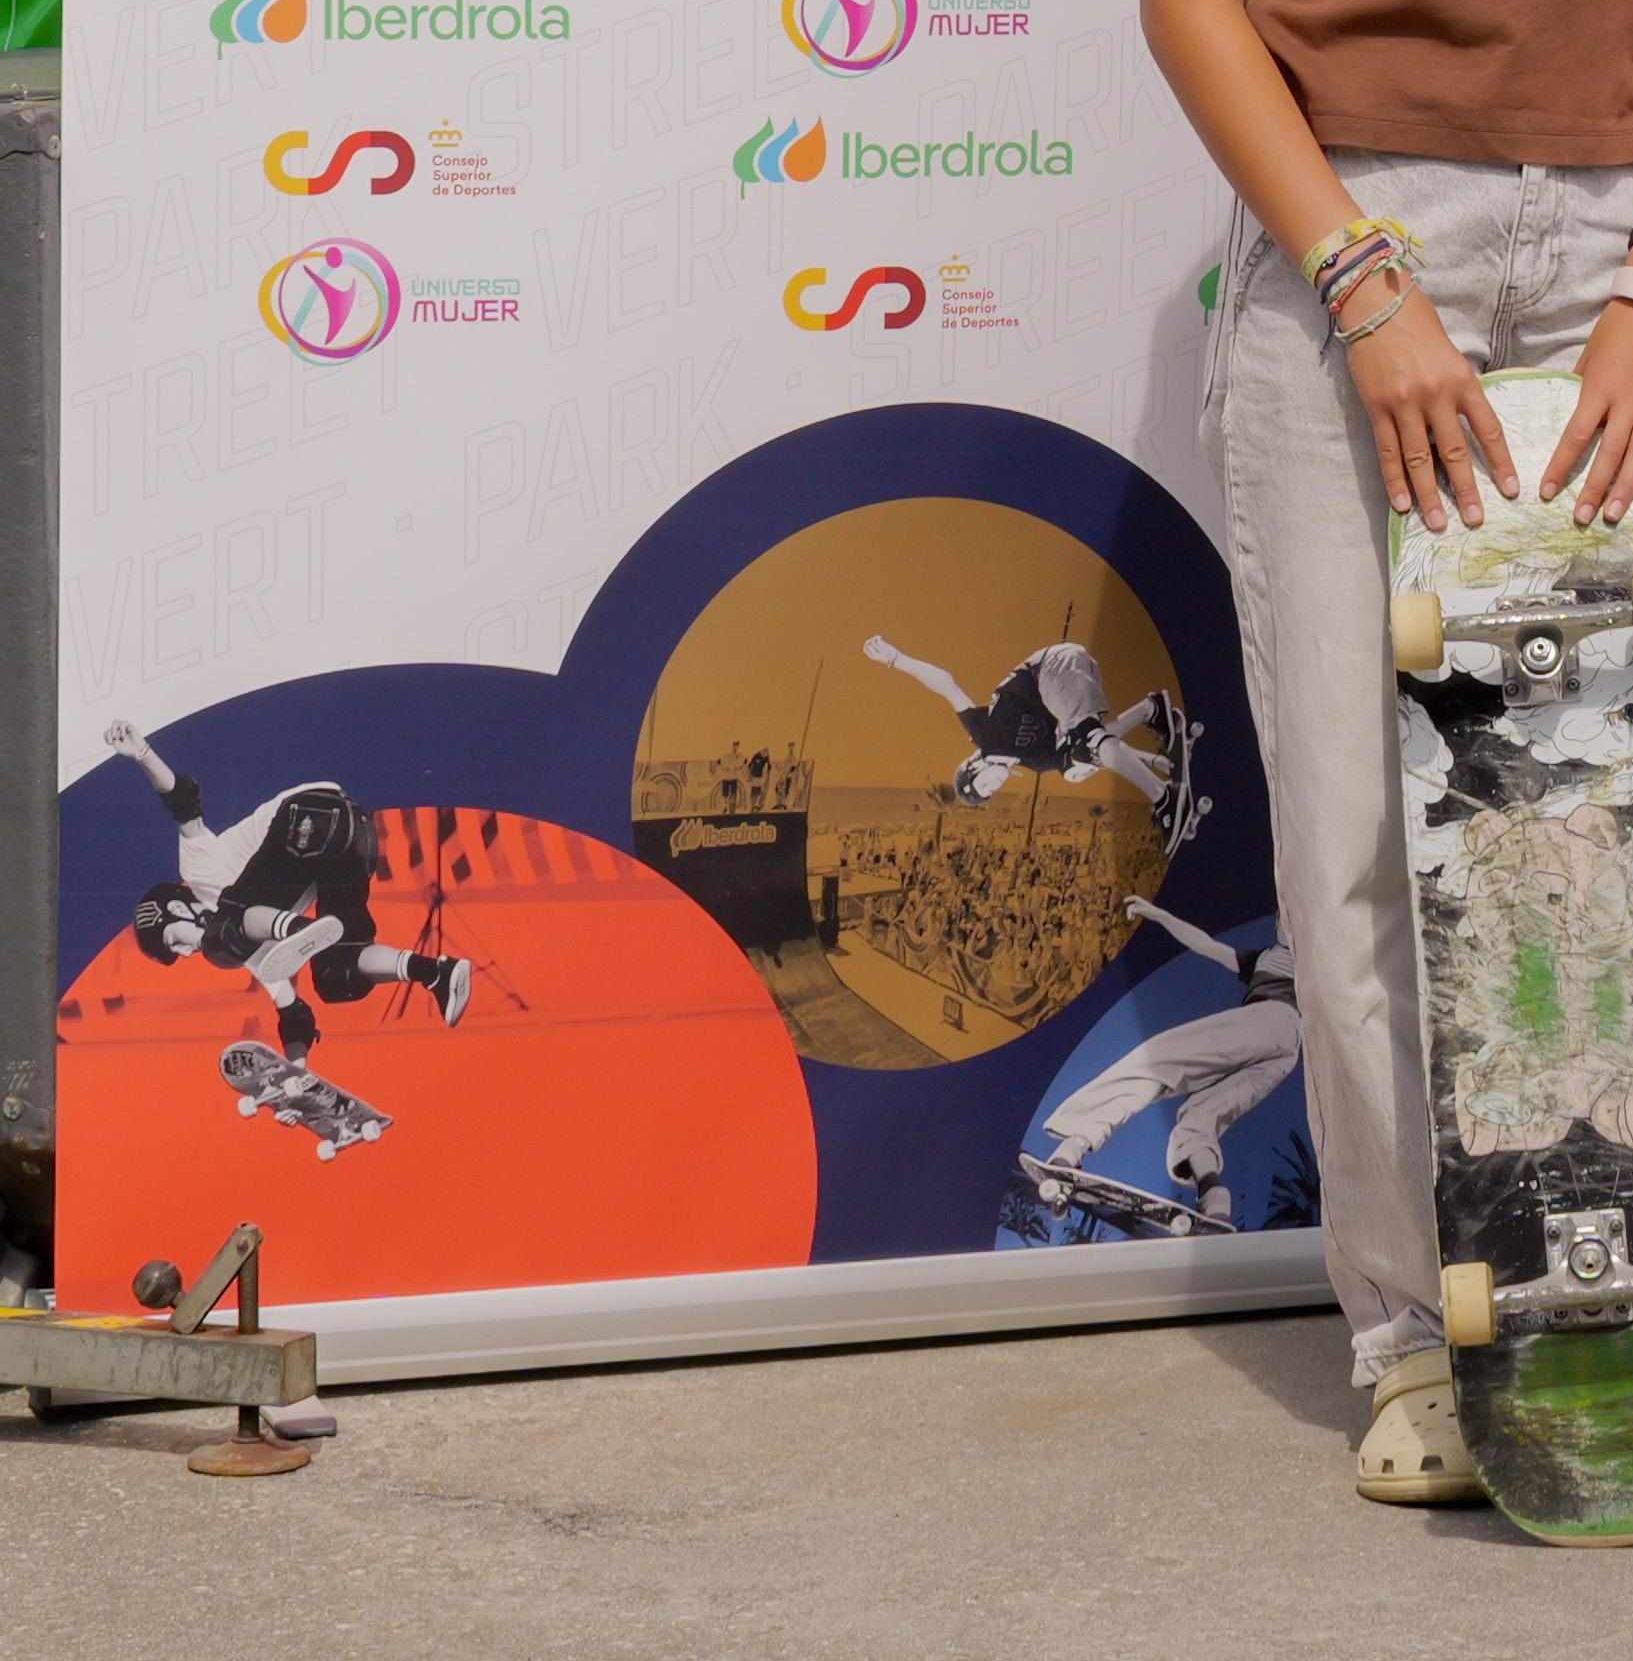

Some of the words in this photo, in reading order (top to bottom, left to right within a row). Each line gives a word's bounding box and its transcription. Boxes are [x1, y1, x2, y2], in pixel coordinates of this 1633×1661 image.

[928, 13, 1029, 36] MUJER
[843, 129, 1072, 178] Iberdrola
[432, 154, 488, 168] Consejo
[433, 169, 491, 183] Superior
[433, 184, 449, 195] de
[454, 184, 516, 198] Deportes
[412, 279, 520, 296] UNIVERSO
[942, 288, 994, 301] Consejo
[413, 300, 520, 323] MUJER
[943, 302, 997, 314] Superior
[942, 318, 957, 328] de
[962, 317, 1019, 330] Deportes
[704, 820, 776, 846] Iberdrola
